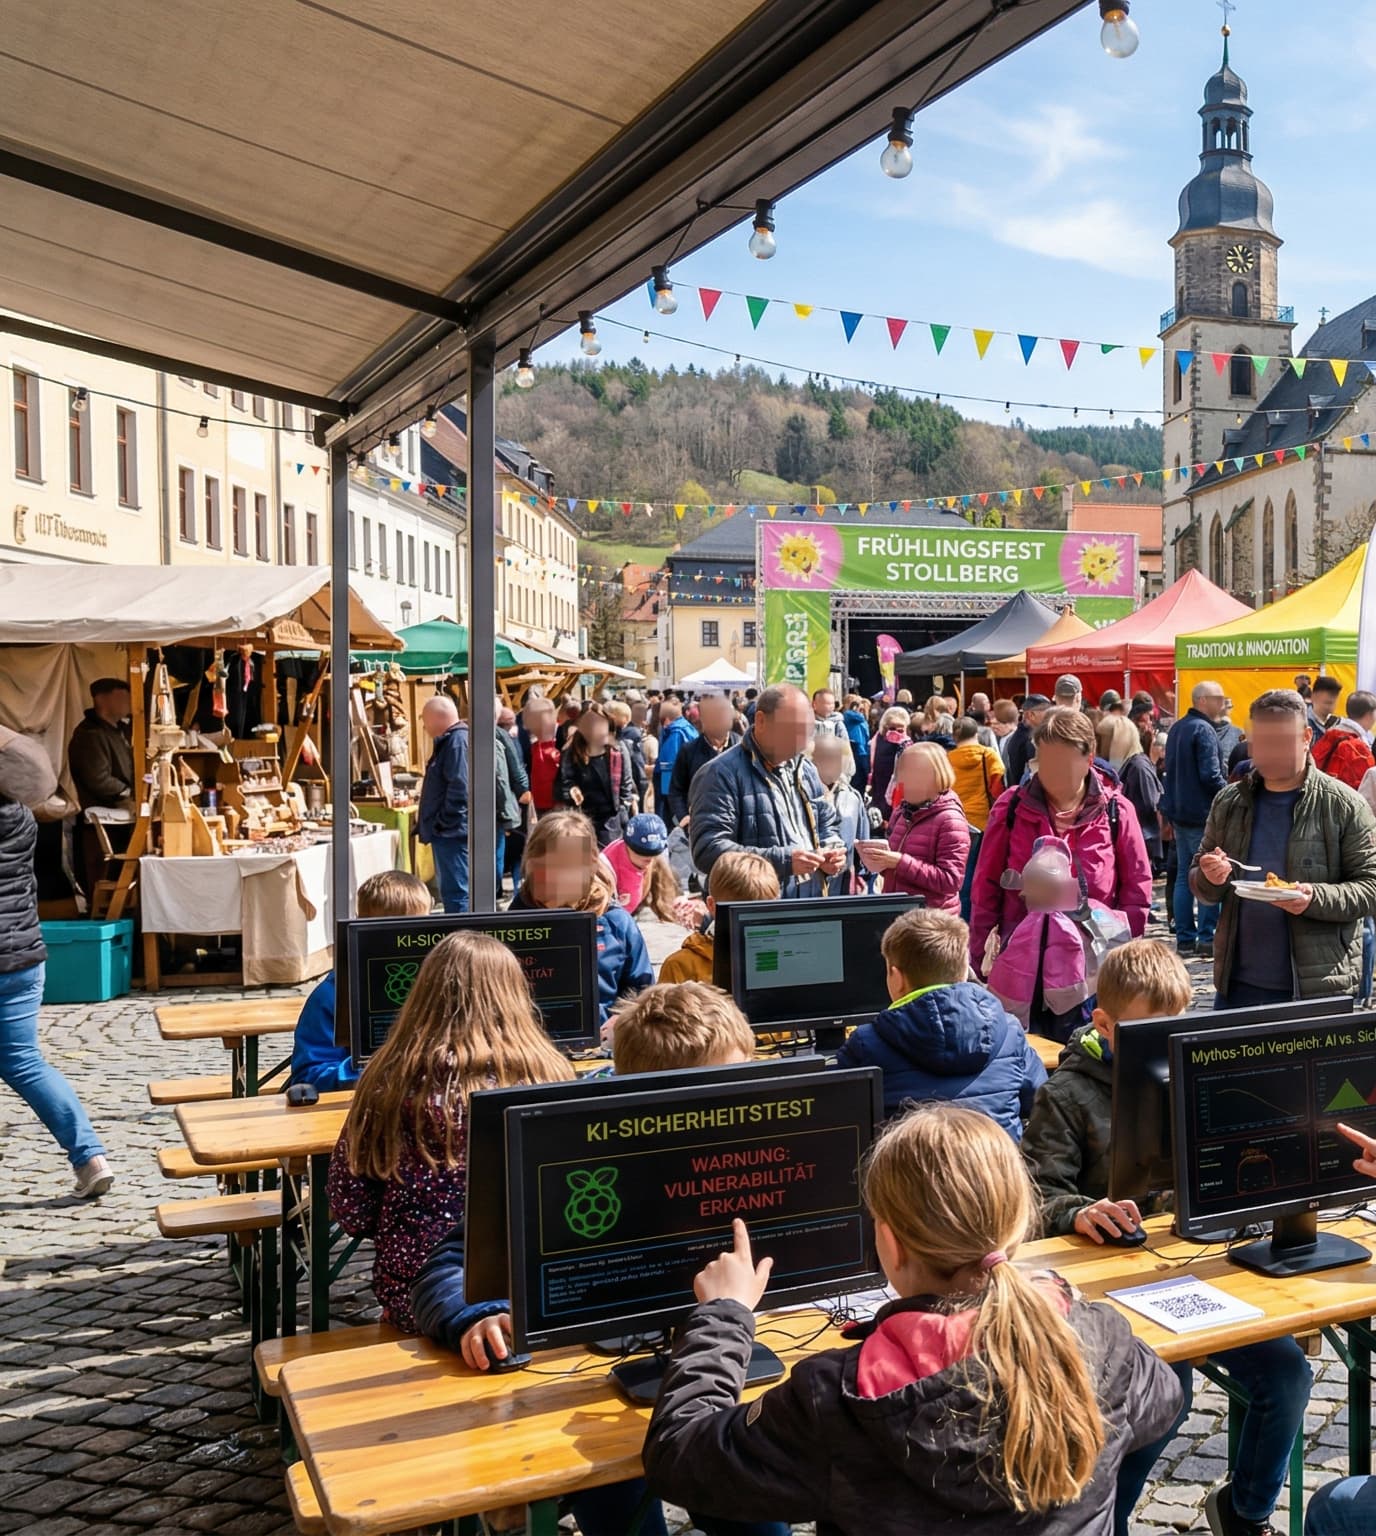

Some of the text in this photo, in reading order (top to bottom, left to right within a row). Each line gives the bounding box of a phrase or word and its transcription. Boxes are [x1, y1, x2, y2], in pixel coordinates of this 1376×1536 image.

[857, 533, 1046, 560] FRÜHLINGSFEST
[886, 562, 1019, 583] STOLLBERG
[1186, 642, 1235, 658] TRADITION
[1237, 642, 1244, 657] &
[1191, 1041, 1265, 1066] Mythos-Tool
[1267, 1036, 1323, 1055] Vergleich:
[1339, 1034, 1355, 1046] vs.
[586, 1098, 815, 1143] KI-SICHERHEITSTEST
[691, 1147, 791, 1173] WARNUNG:
[663, 1162, 817, 1199] VULNERABILITÄT
[699, 1190, 787, 1217] ERKANNT
